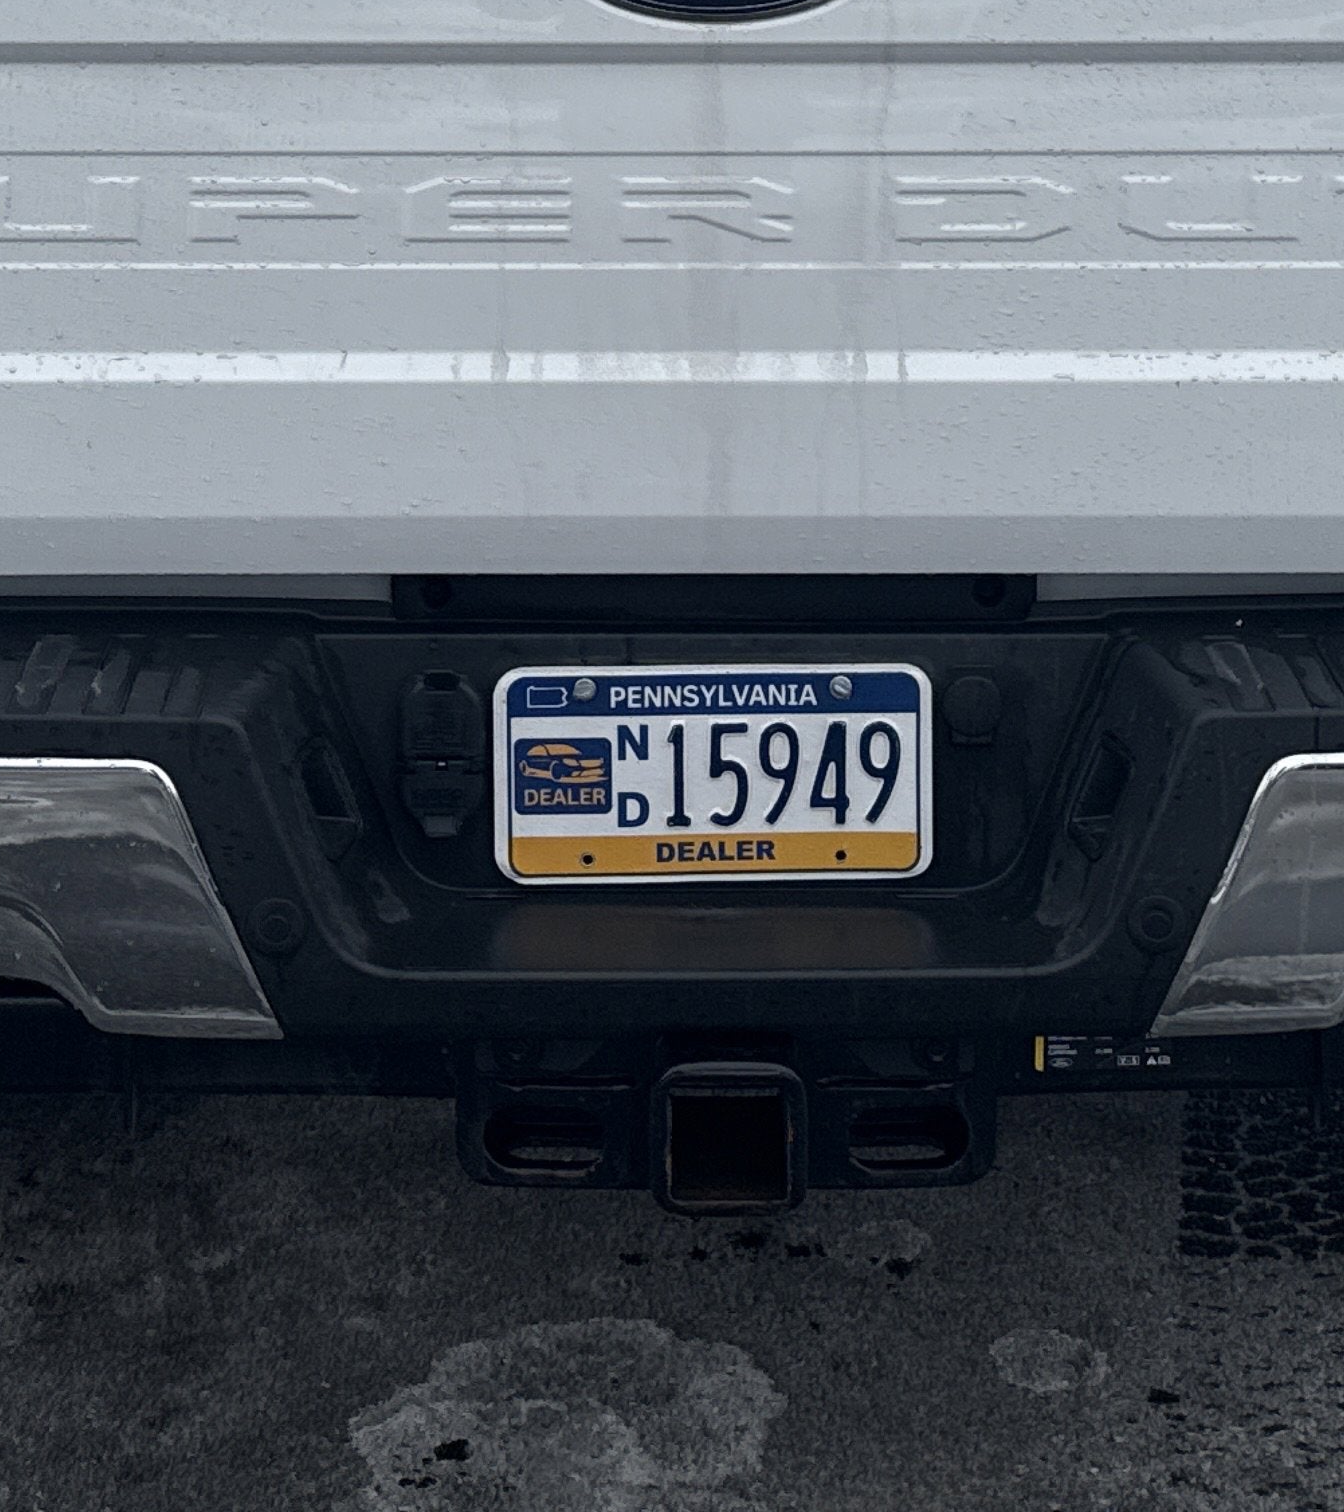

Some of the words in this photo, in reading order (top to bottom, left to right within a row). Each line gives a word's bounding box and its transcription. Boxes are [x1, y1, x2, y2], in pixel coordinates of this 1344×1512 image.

[609, 684, 818, 709] PENNSYLVANIA
[666, 720, 902, 828] 15949
[523, 788, 607, 807] DEALER
[656, 840, 776, 863] DEALER
